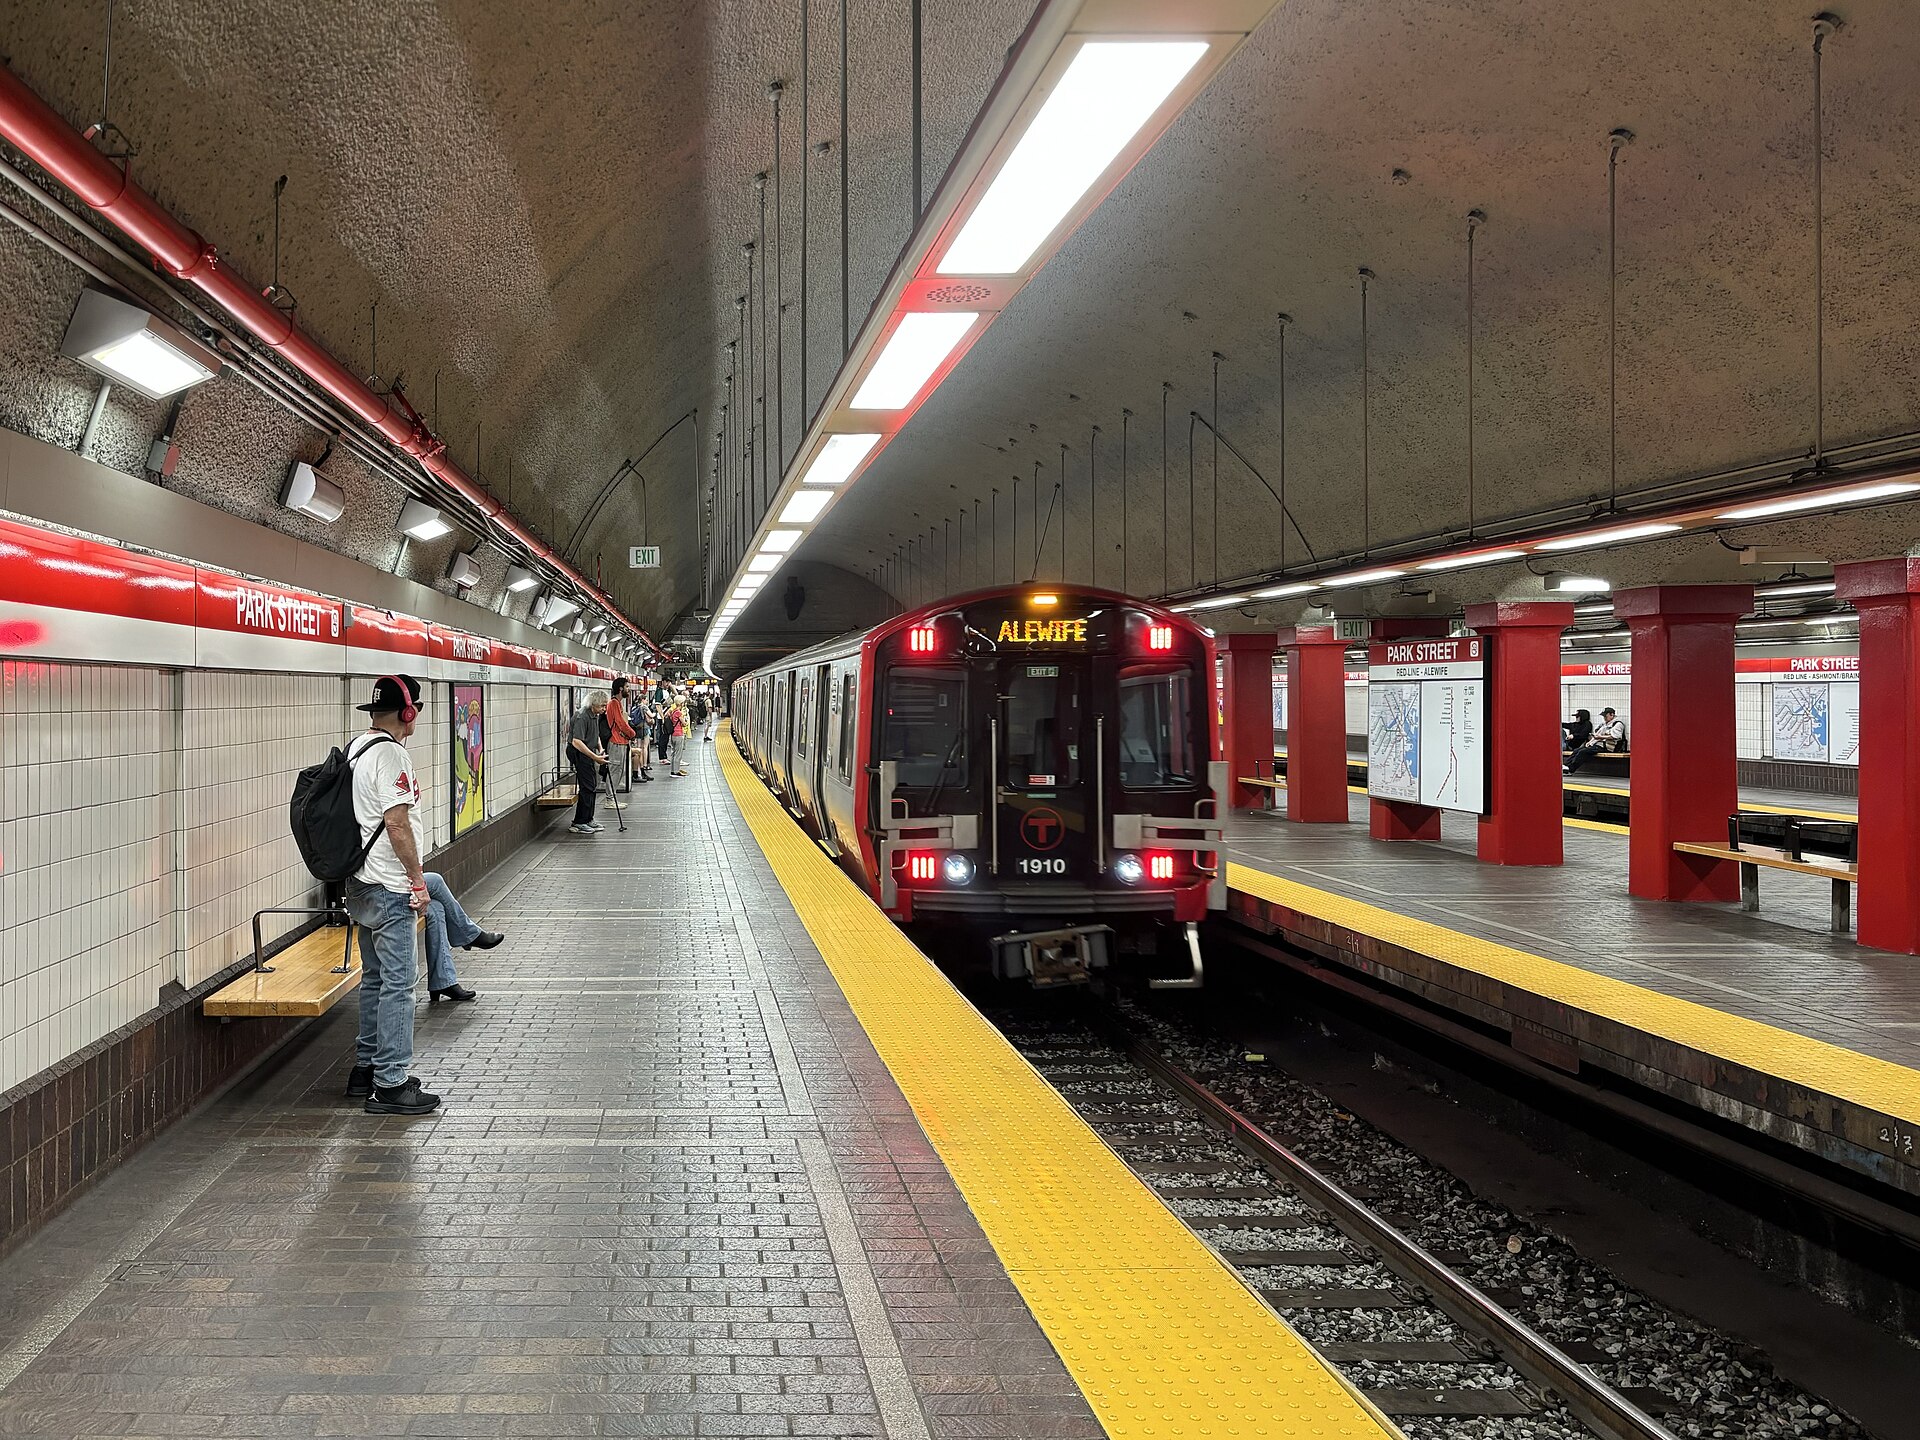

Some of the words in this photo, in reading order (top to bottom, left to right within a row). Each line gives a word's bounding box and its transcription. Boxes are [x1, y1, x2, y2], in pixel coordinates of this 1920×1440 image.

[635, 549, 655, 564] EXIT
[236, 586, 275, 630] PARK
[278, 594, 320, 636] STREET
[997, 620, 1088, 642] ALEWIFE
[1343, 621, 1364, 637] EXIT
[1387, 644, 1414, 663] PARK
[1416, 641, 1459, 661] STREET
[1030, 668, 1047, 676] EXIT
[1396, 668, 1407, 677] RED
[1407, 667, 1420, 676] LINE
[1423, 666, 1448, 676] ALEWIFE
[1588, 665, 1606, 675] PARK
[1606, 664, 1631, 674] STREE
[1790, 659, 1820, 671] PARK
[1821, 658, 1859, 670] STREE
[1028, 818, 1057, 843] T
[1019, 858, 1066, 874] 1910
[1515, 1016, 1575, 1046] DANGER
